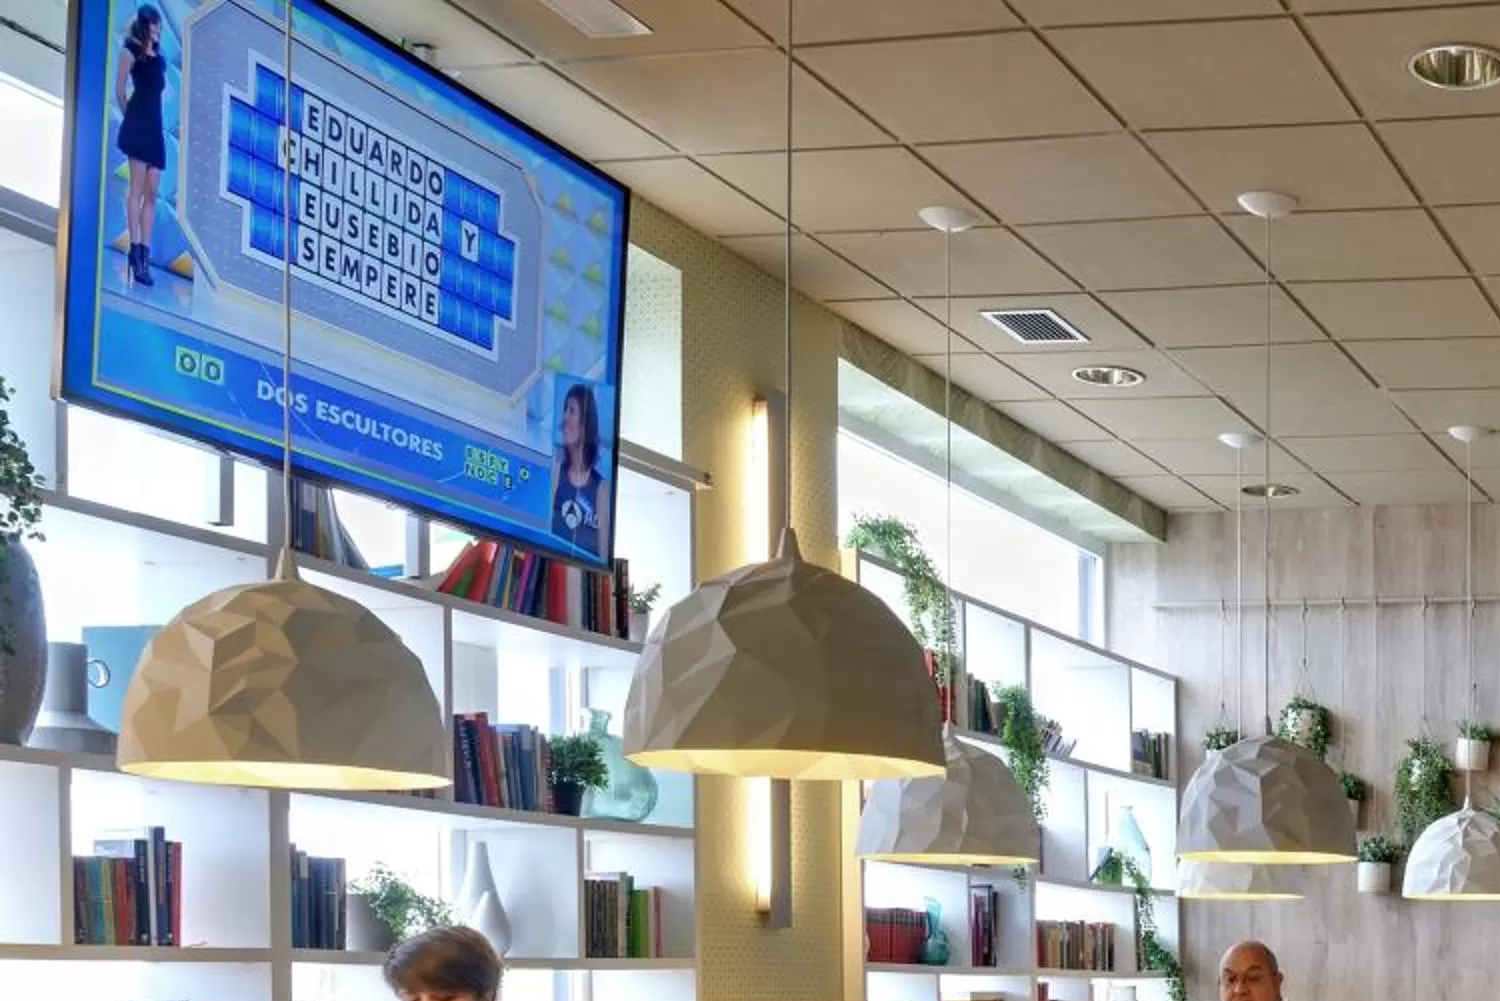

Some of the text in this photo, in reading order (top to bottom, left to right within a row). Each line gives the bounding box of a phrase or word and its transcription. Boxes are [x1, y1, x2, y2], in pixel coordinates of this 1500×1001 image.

[308, 105, 443, 195] EDUARDO
[283, 137, 477, 251] CHILLIDA Y
[304, 193, 440, 277] EUSEBIO
[302, 236, 436, 316] SEMPERE
[256, 379, 309, 414] DOS
[315, 400, 444, 462] ESCULTORES
